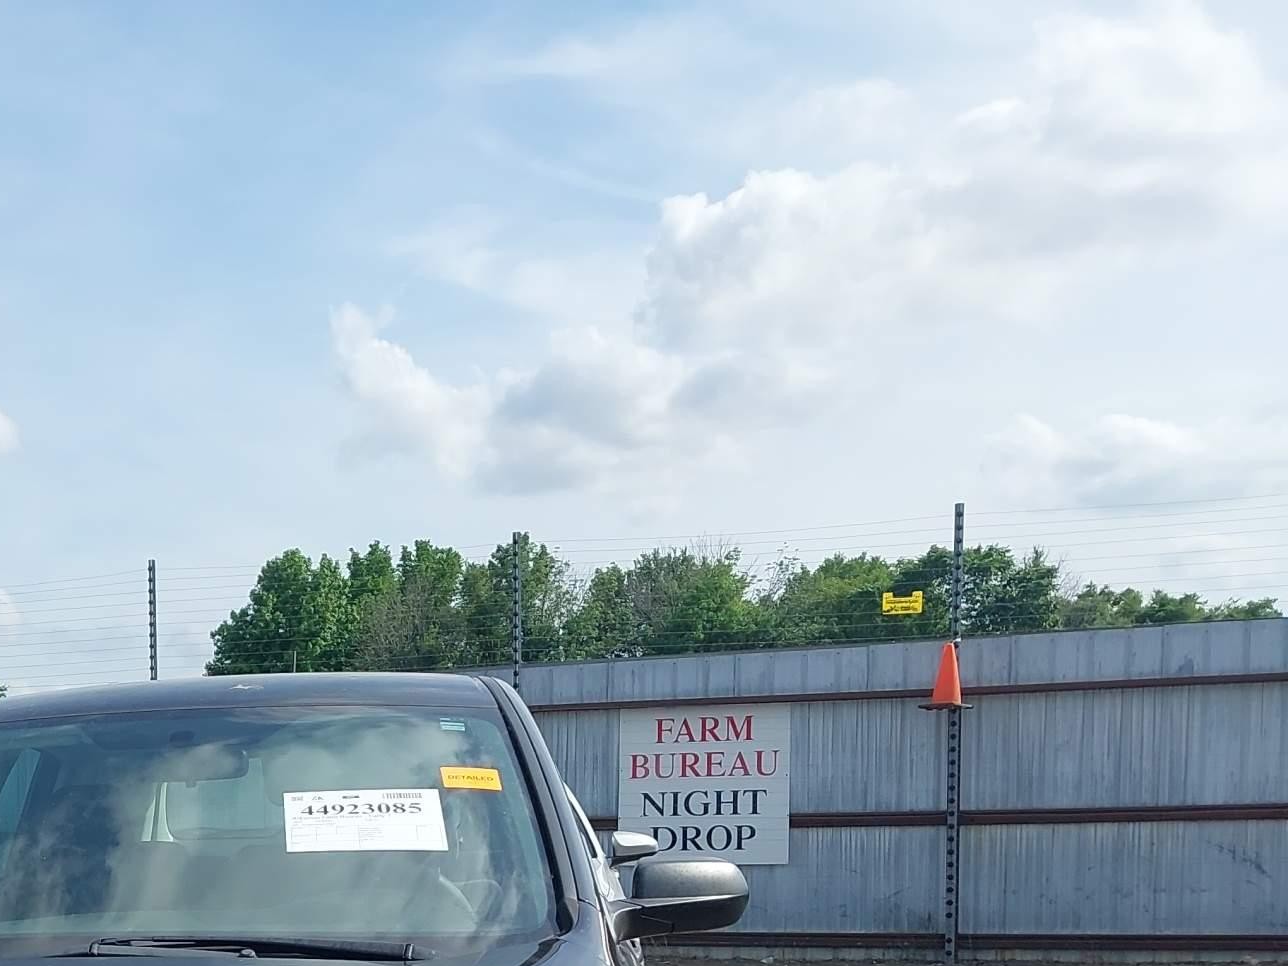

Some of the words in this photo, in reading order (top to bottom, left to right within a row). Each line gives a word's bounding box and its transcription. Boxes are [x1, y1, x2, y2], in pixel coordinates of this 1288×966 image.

[655, 715, 754, 744] FARM
[447, 774, 494, 782] DETAILED
[628, 750, 780, 779] BUREAU
[300, 802, 423, 815] 44923085
[640, 789, 768, 817] NIGHT
[650, 824, 757, 851] DROP
